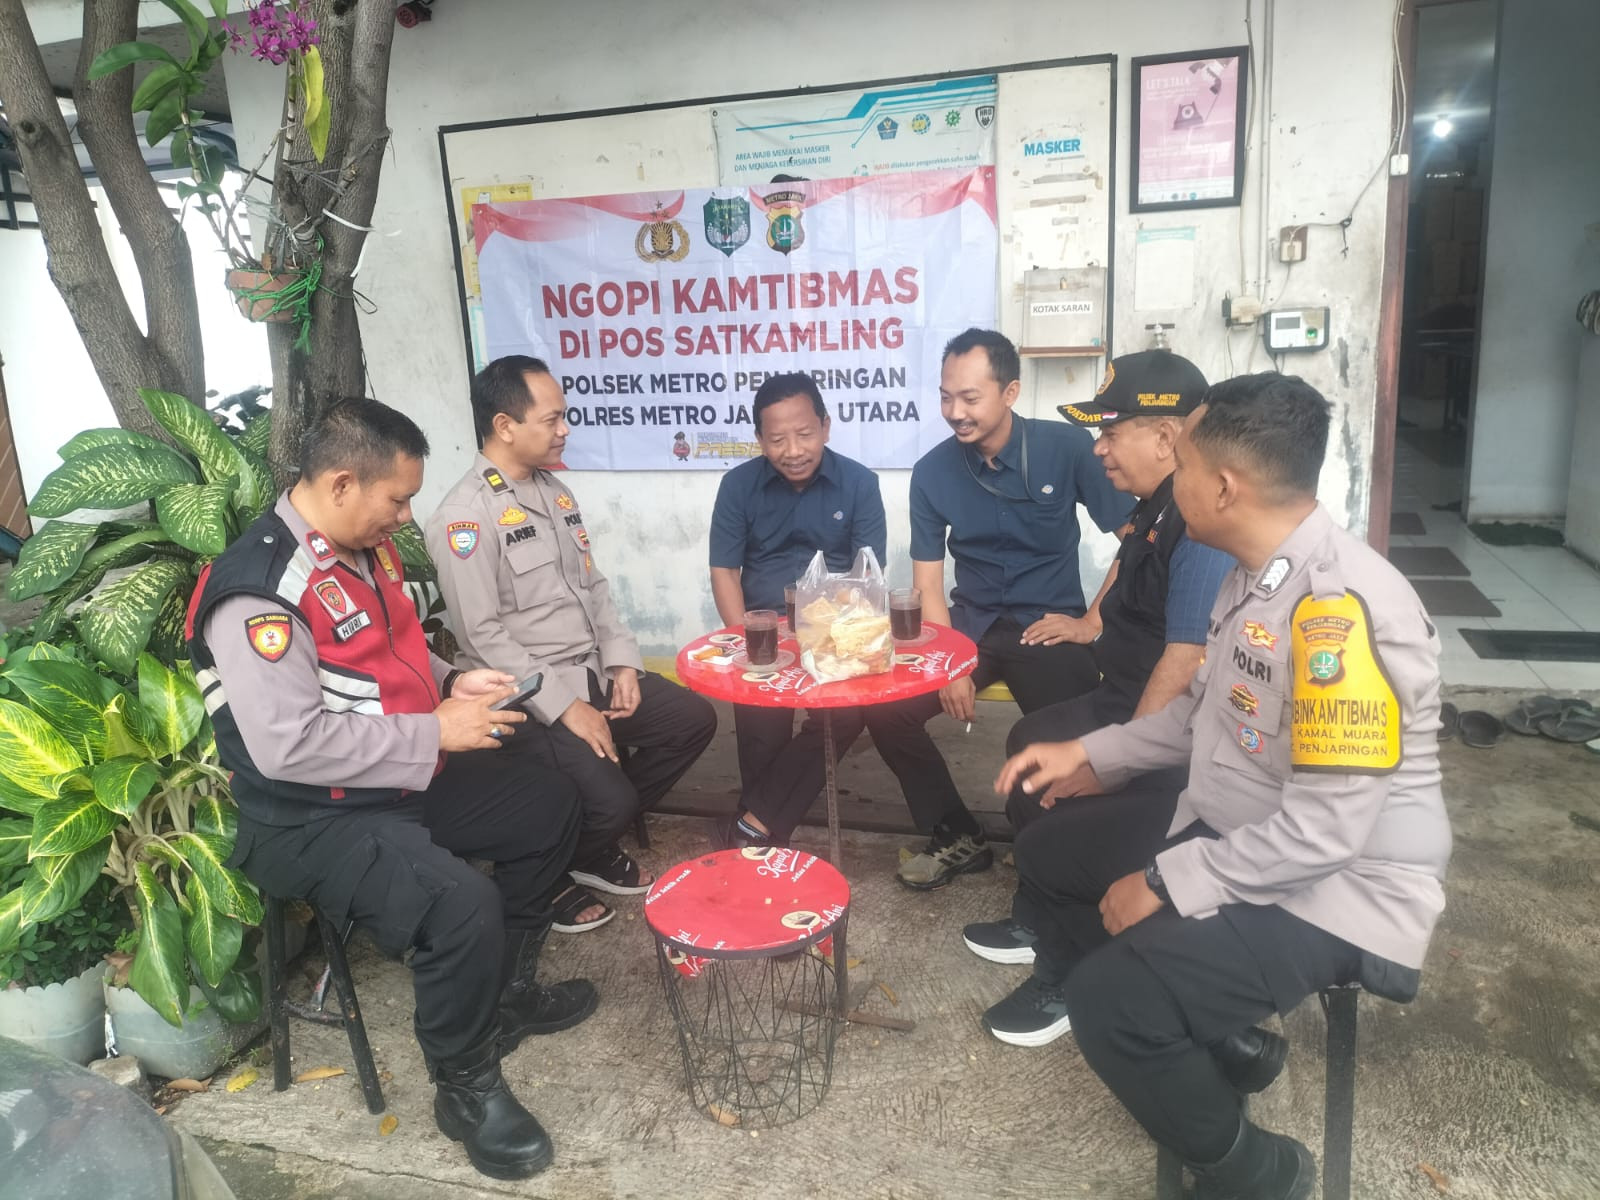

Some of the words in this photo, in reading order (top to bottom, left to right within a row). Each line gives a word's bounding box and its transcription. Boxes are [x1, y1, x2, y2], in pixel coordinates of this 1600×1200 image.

[772, 148, 802, 157] MEMAKAI
[804, 145, 830, 154] MASKER
[1024, 139, 1081, 156] MASKER
[735, 164, 747, 172] DAN
[542, 280, 661, 318] NGOPI
[672, 266, 919, 314] KAMTIBMAS
[1033, 304, 1060, 313] KOTAK
[1061, 303, 1091, 312] SARAN
[559, 329, 590, 359] DI
[599, 326, 665, 358] POS
[674, 317, 904, 356] SATKAMLING
[561, 374, 644, 395] POLSEK
[651, 372, 727, 394] METRO
[735, 367, 906, 392] PERINGAN
[563, 405, 635, 426] OLRES
[641, 405, 717, 426] METRO
[838, 401, 920, 422] UTARA
[1233, 645, 1272, 682] POLRI
[1297, 729, 1336, 739] KAMAL
[1343, 730, 1387, 741] MUARA
[1300, 744, 1388, 756] PENJARINGAN
